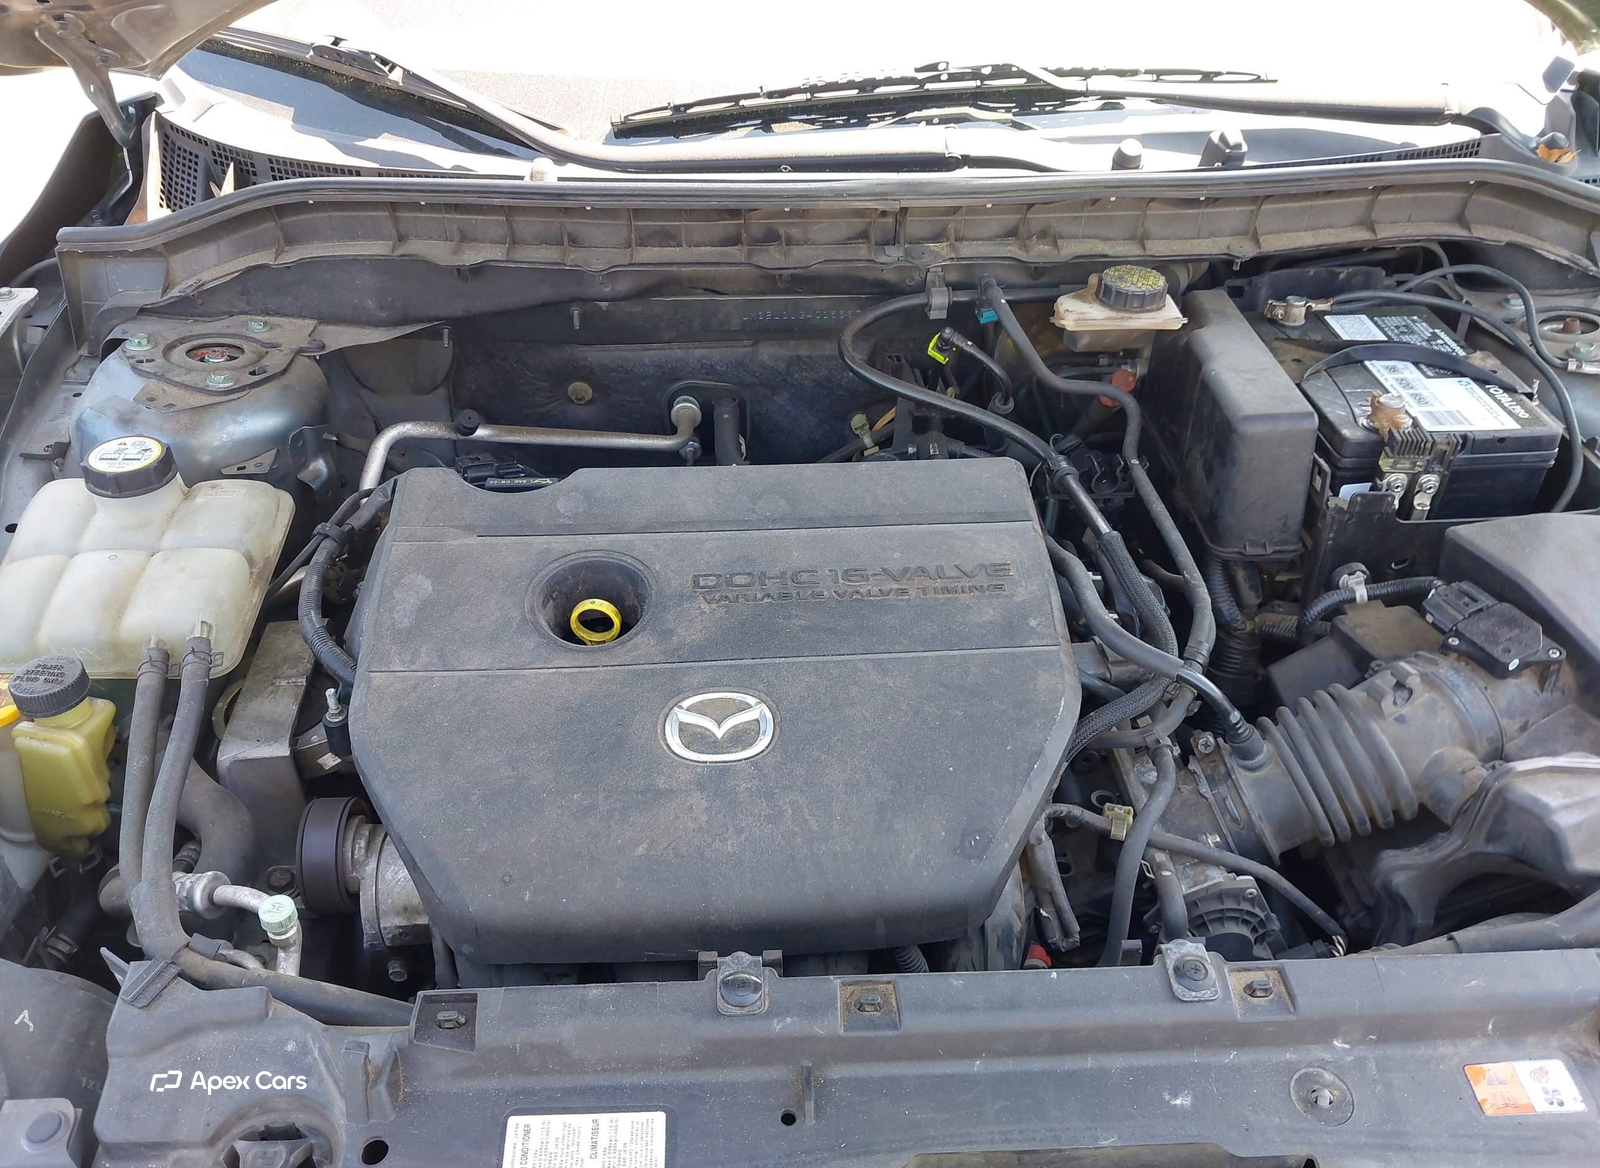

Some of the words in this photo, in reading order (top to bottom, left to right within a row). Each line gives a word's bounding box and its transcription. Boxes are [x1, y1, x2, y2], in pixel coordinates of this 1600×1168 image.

[692, 569, 821, 590] DOHC
[827, 562, 1014, 585] 16-VALVE
[701, 590, 827, 604] VARIABLE
[832, 587, 911, 600] VALVE
[917, 584, 1007, 597] TIMING
[23, 669, 66, 678] STEERING
[35, 663, 65, 671] POWER
[13, 675, 40, 683] FLUID
[43, 677, 65, 685] ONLY
[520, 1124, 532, 1165] CONDITIONER
[590, 1119, 600, 1160] CLIMATISEUR
